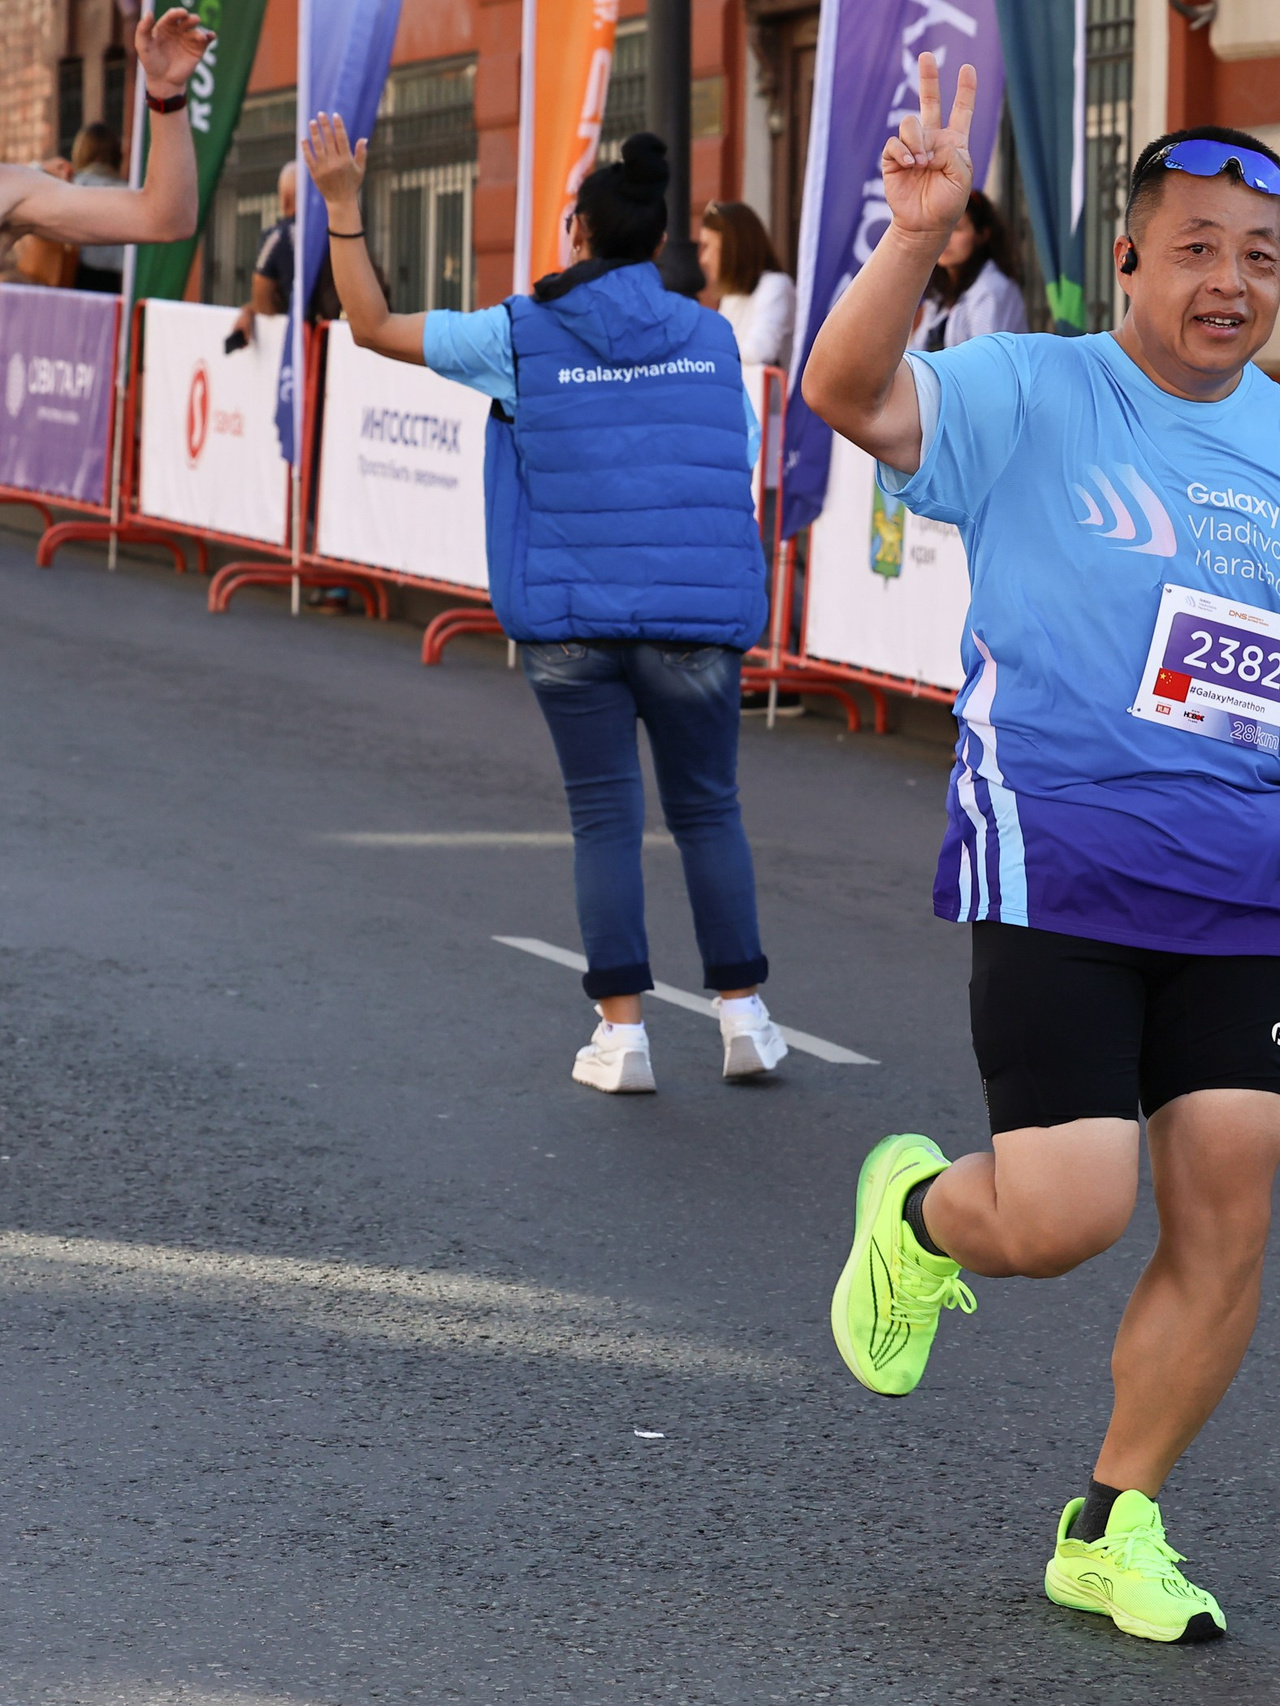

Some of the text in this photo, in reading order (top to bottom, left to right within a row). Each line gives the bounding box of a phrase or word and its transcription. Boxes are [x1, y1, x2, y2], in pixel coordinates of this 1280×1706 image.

[558, 357, 715, 384] #GalaxyMarathon
[360, 406, 461, 454] ИНГОССТРАХ
[1186, 482, 1280, 529] Galaxy
[1228, 609, 1248, 621] DNS
[1189, 685, 1266, 714] #GalaxyMarathon
[1230, 720, 1280, 750] 28km
